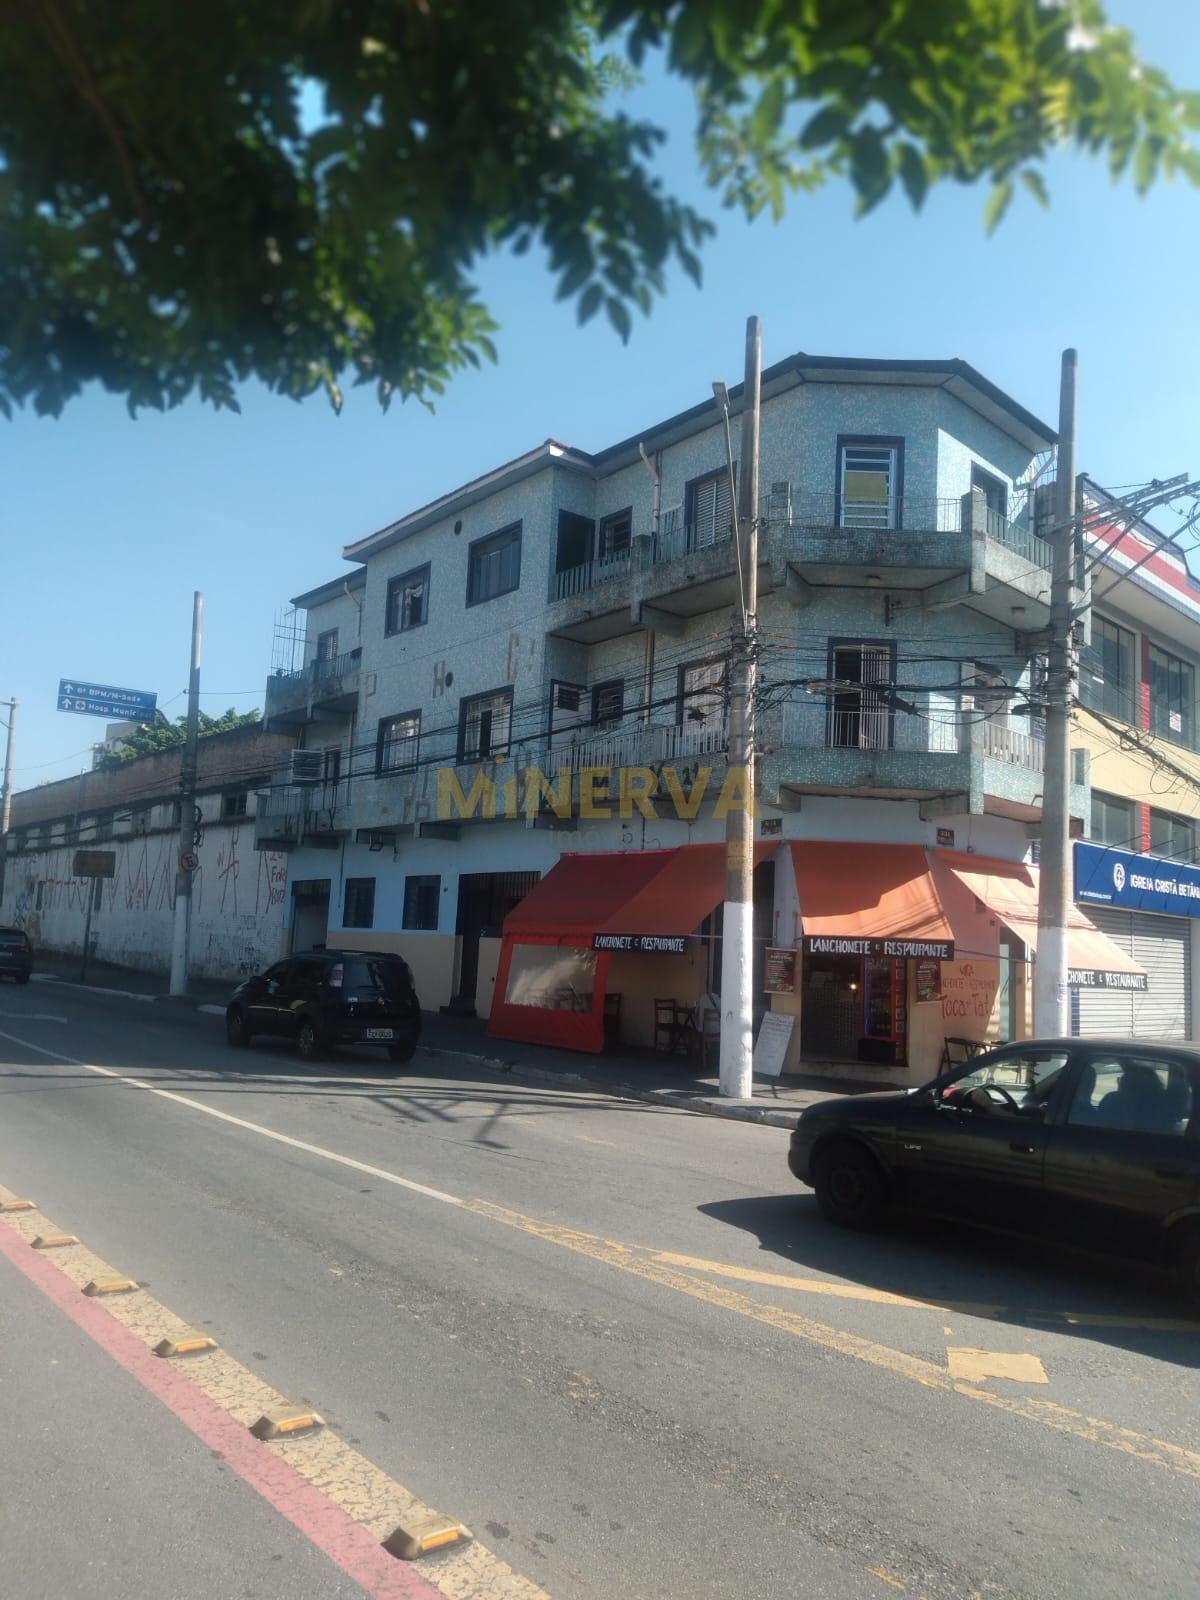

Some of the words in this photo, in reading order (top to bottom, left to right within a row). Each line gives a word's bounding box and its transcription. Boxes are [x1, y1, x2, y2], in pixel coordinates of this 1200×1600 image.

[1130, 874, 1154, 891] IGREJA
[1155, 878, 1178, 895] CRISTÃ
[1178, 881, 1200, 899] BETÂN
[594, 936, 632, 949] LANCHONETE
[641, 937, 685, 952] RESTAURANTE
[810, 938, 871, 954] LANCHONETE
[884, 941, 948, 957] RESTAURANTE
[1067, 970, 1095, 985] CHONETE
[1105, 972, 1146, 988] RESTAURANTE
